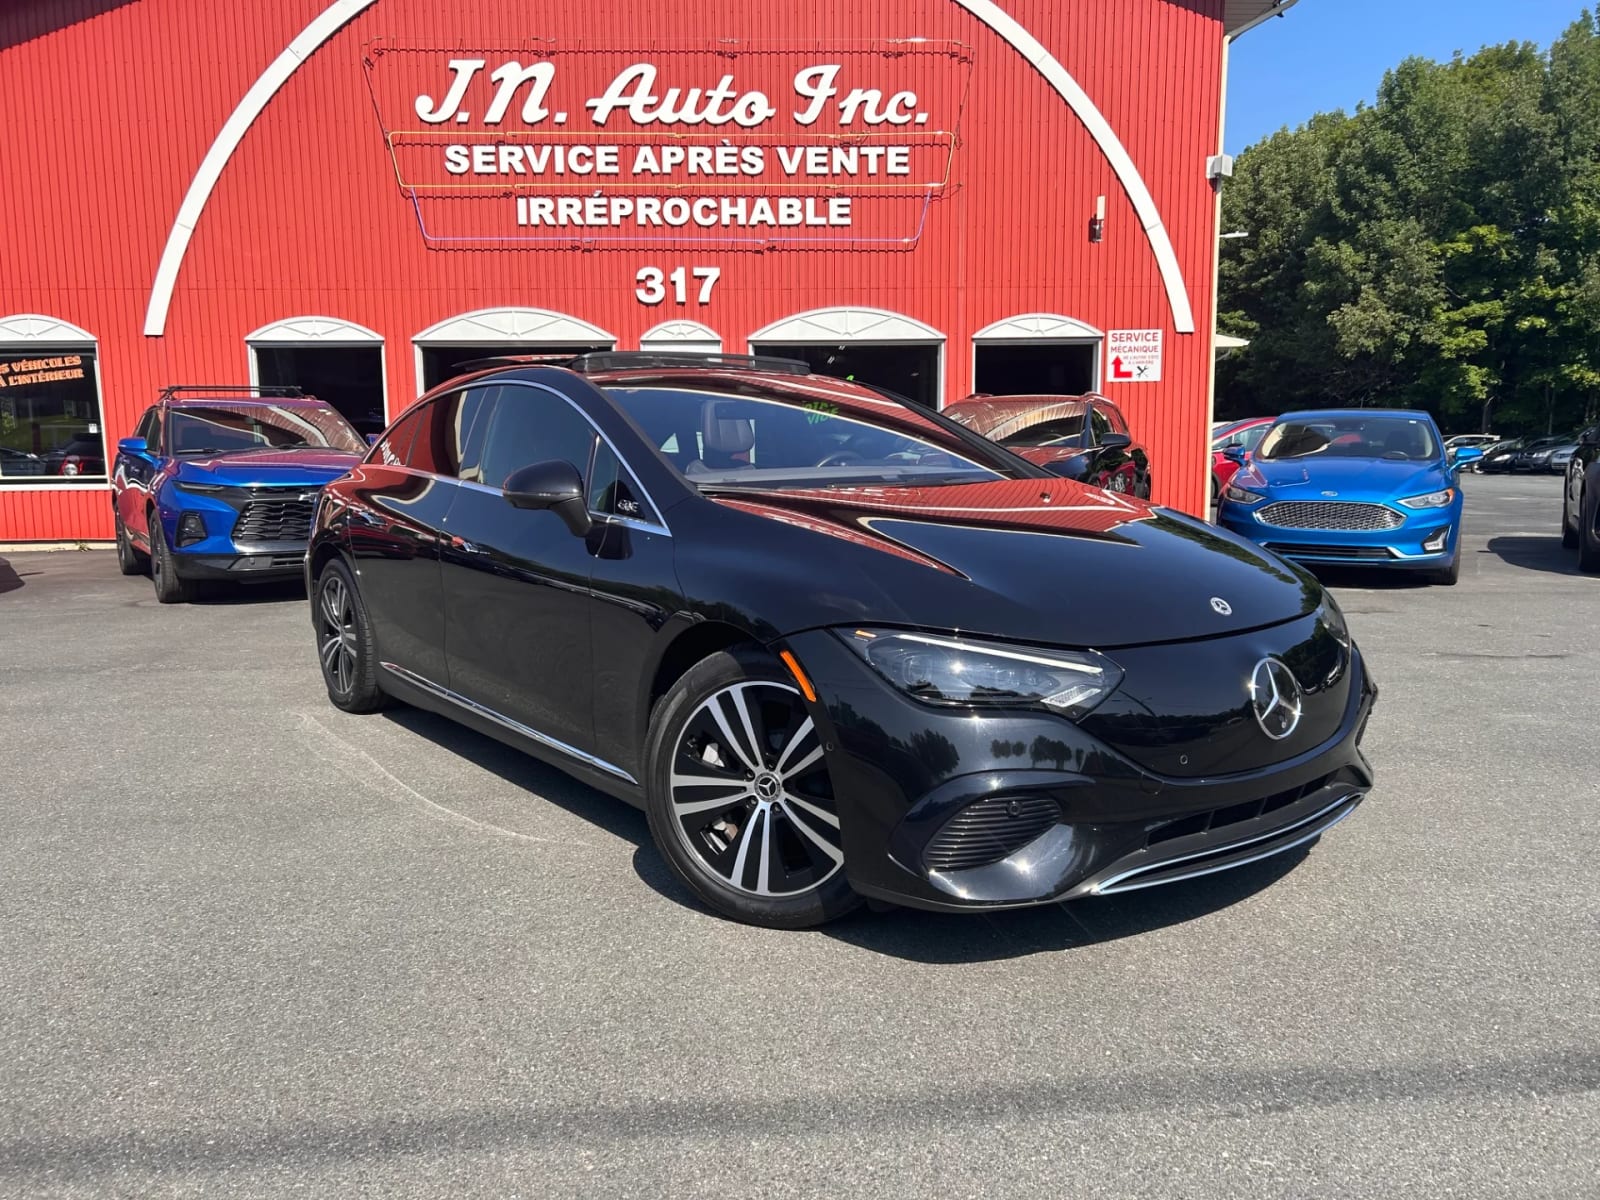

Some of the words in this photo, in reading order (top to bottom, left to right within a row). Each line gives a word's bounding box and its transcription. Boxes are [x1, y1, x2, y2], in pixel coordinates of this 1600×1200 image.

[585, 63, 776, 127] Auto
[793, 64, 928, 126] Inc.
[444, 145, 619, 174] SERVICE
[632, 139, 764, 175] APRÈS
[776, 146, 909, 174] VENTE
[516, 190, 851, 226] IRRÉPROCHABLE
[635, 266, 721, 304] 317
[1111, 332, 1159, 342] SERVICE
